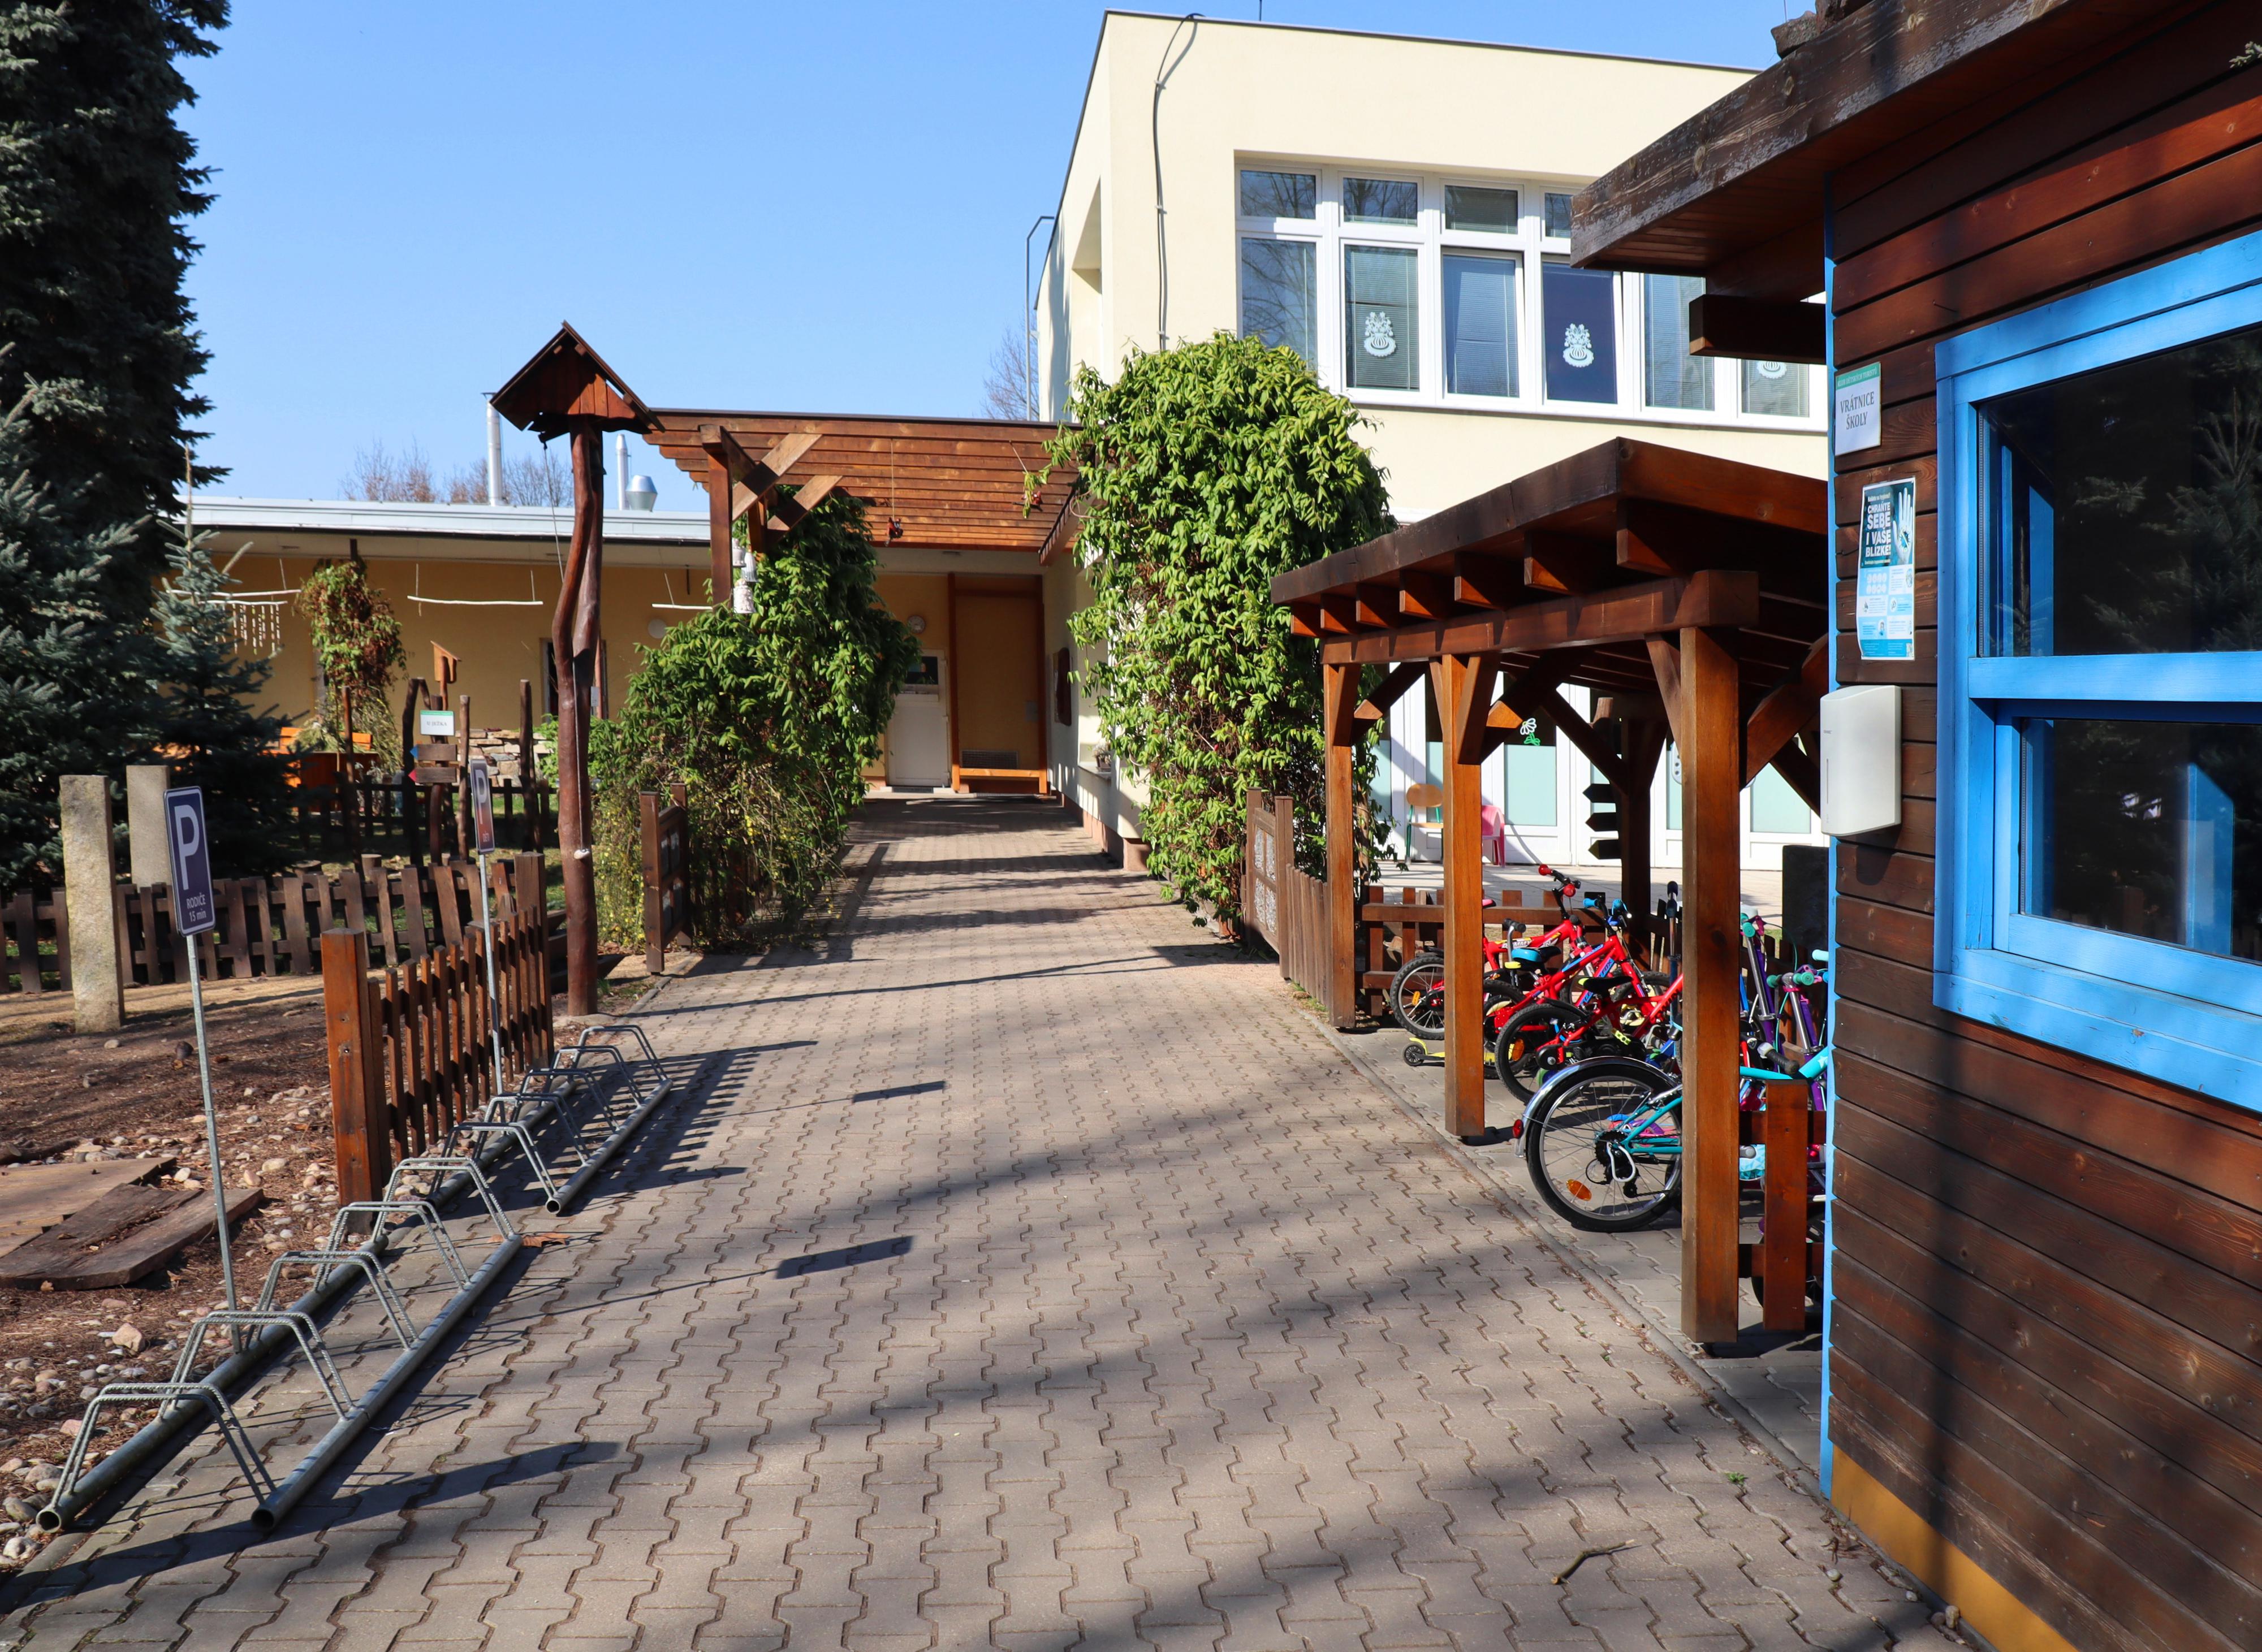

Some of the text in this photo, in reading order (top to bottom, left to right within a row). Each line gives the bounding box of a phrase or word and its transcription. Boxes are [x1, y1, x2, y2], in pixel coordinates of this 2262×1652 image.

[1840, 391, 1875, 413] VRÁTNICE
[1846, 412, 1868, 430] ŠKOLY
[1868, 501, 1890, 514] CHRAŇTE
[1867, 511, 1890, 530] SEBE
[1866, 527, 1891, 545] I VAŠE
[475, 769, 487, 824] P
[174, 805, 200, 890] P
[186, 892, 206, 909] RODIČE
[189, 908, 206, 922] 15 min
